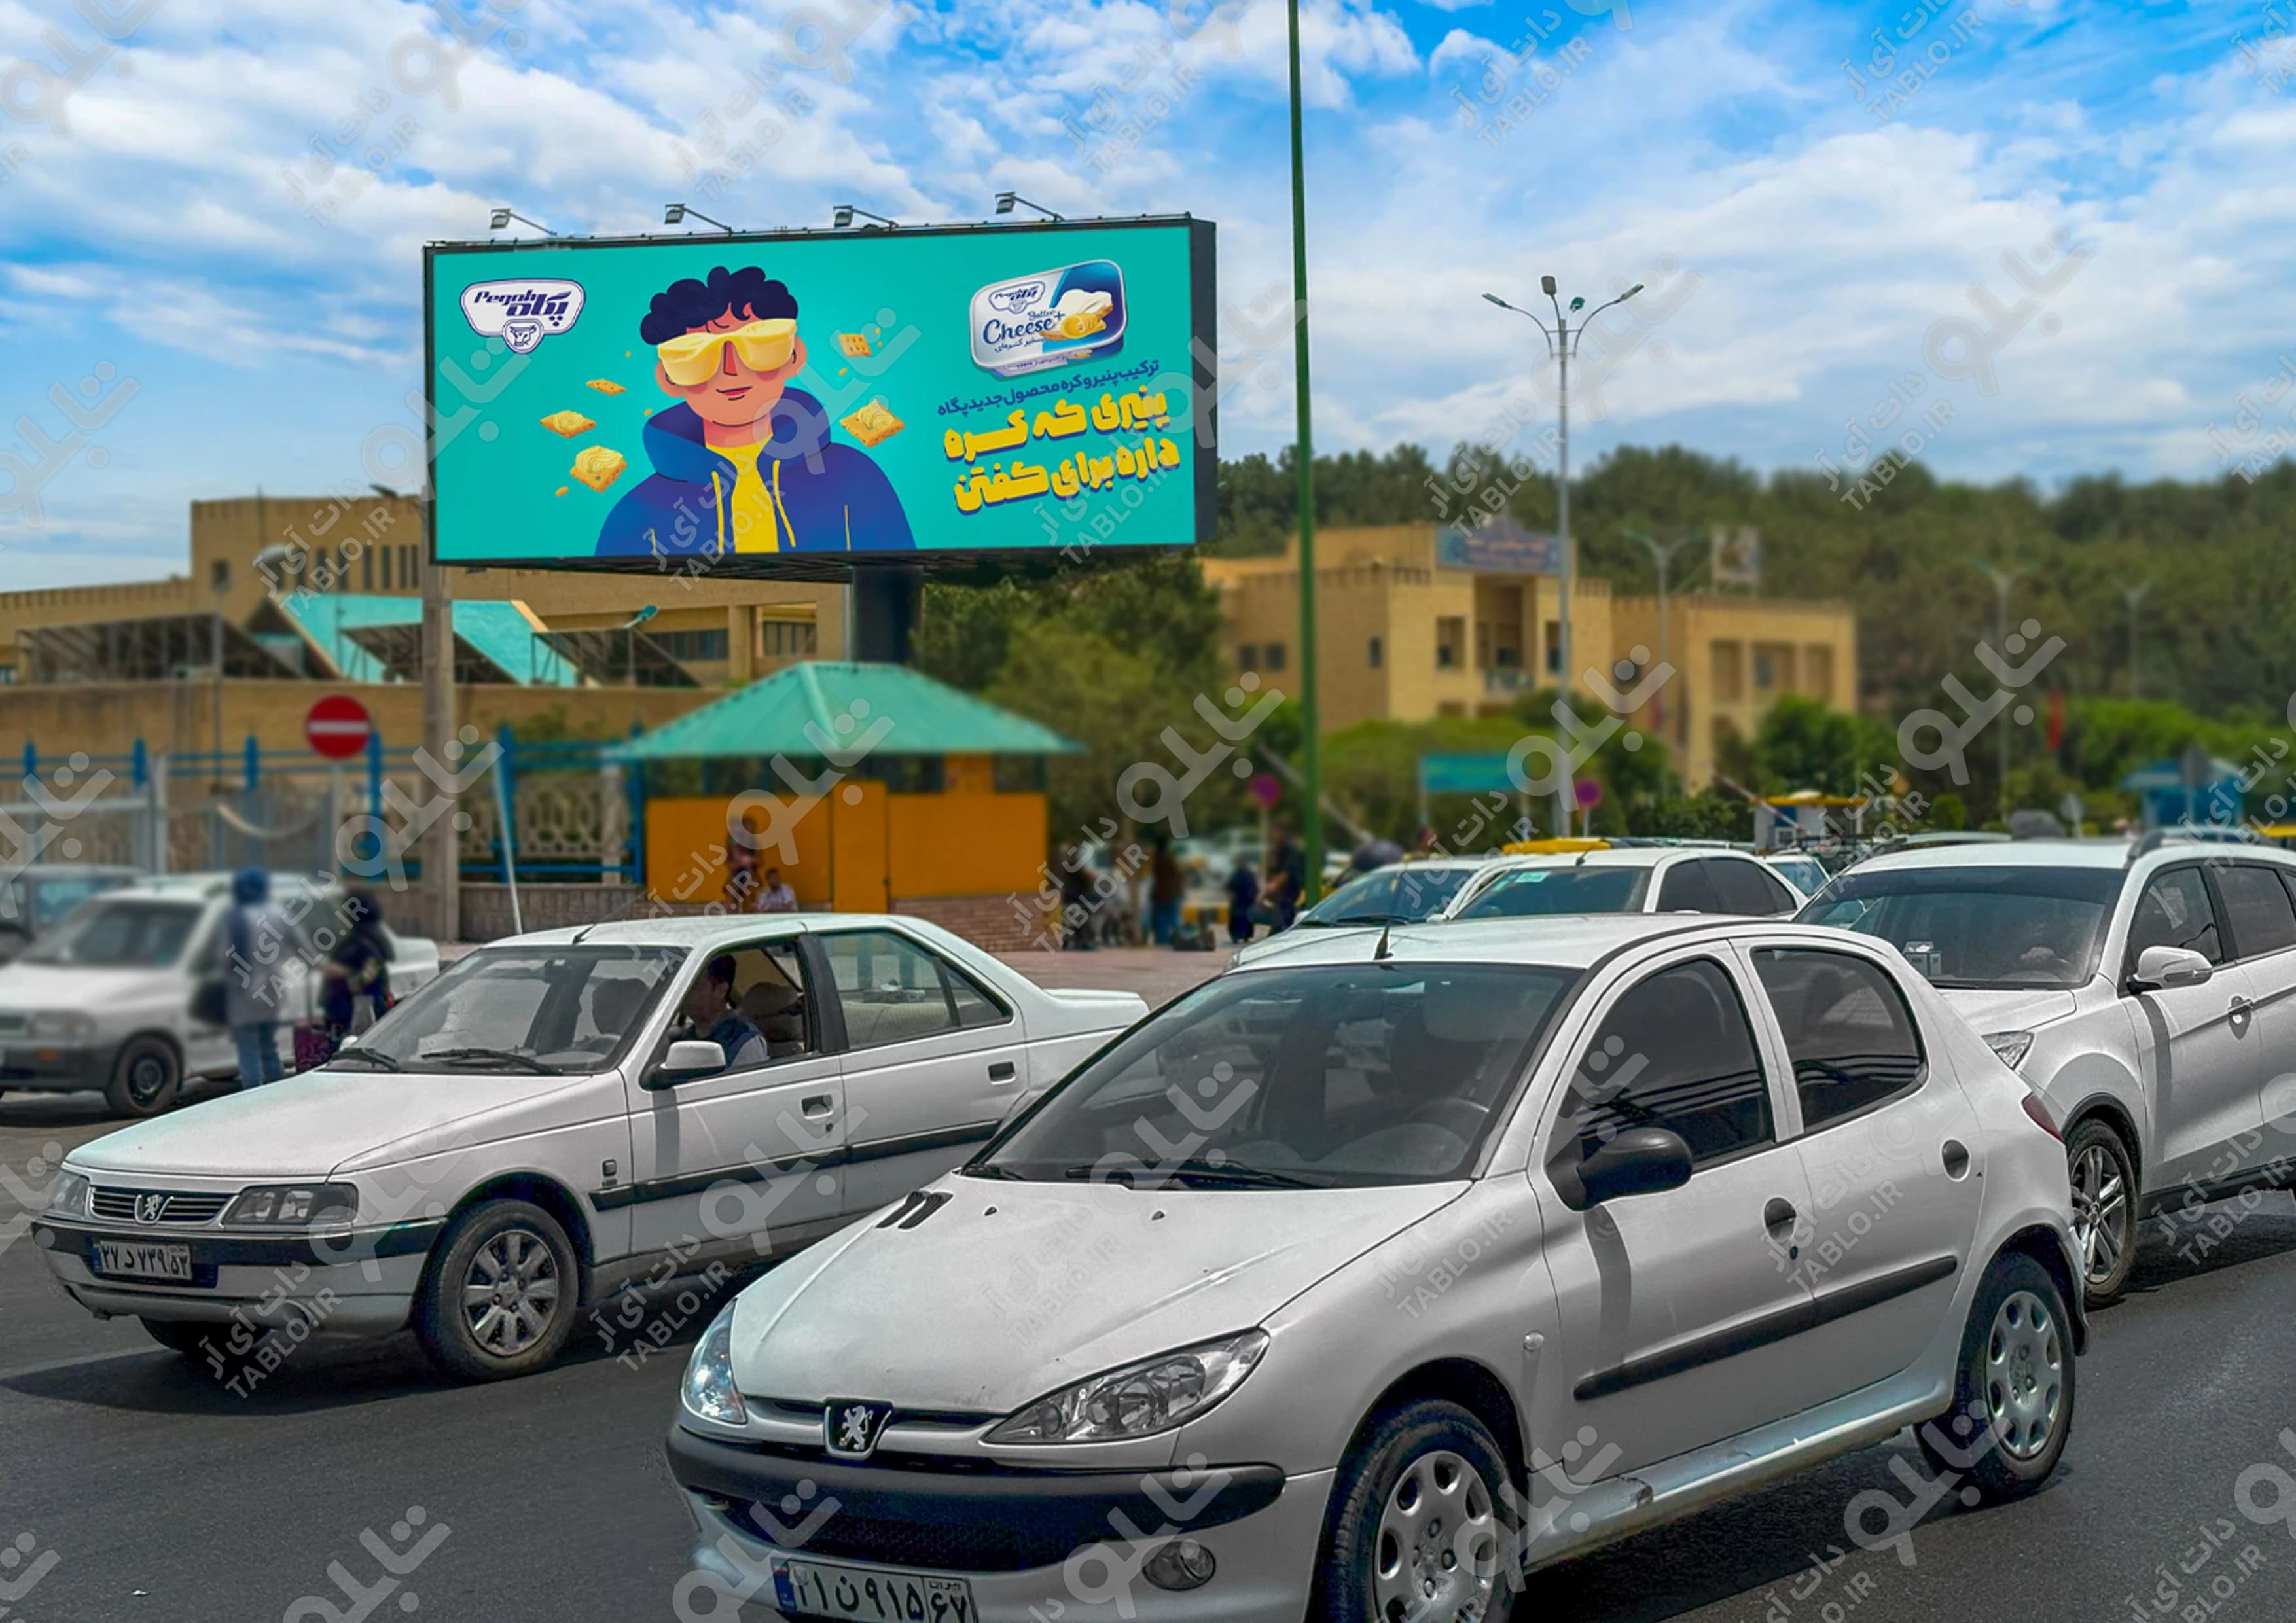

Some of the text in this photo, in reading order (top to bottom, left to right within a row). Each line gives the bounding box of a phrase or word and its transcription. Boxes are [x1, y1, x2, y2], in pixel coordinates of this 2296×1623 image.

[474, 289, 536, 306] Pegah
[506, 291, 571, 327] پگاه
[983, 319, 1056, 345] Cheese
[937, 359, 1160, 418] ترکیب پنیر و کره محصول جدید پگاه
[944, 385, 1170, 466] پنیری که کره
[954, 437, 1180, 516] داره برای گفتن
